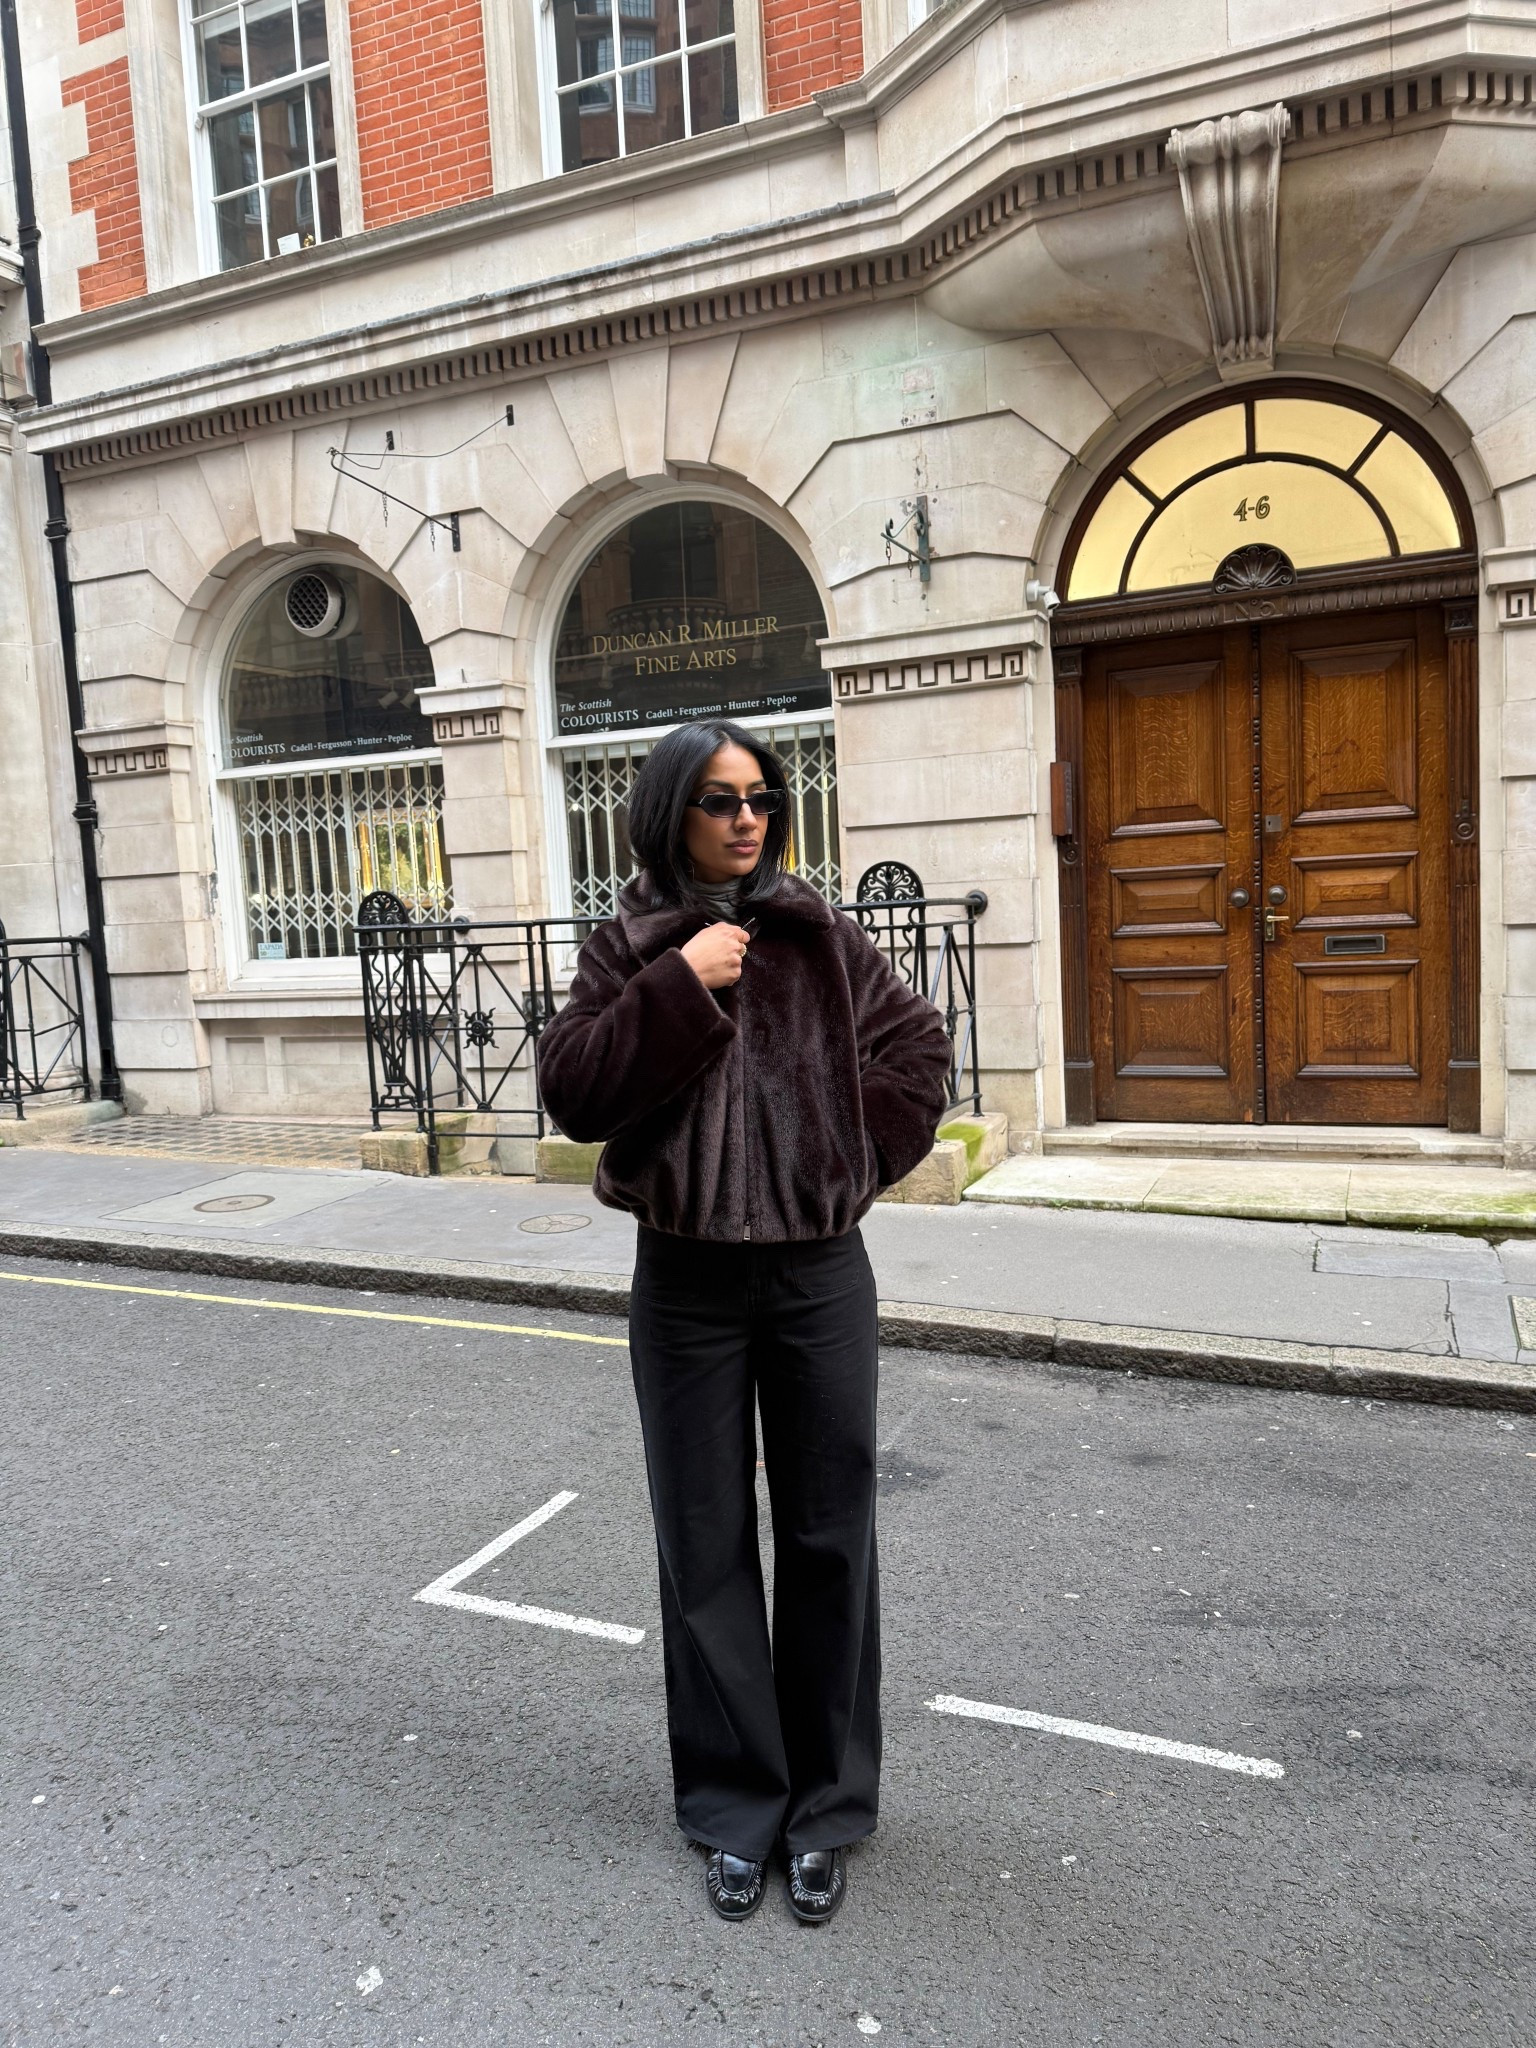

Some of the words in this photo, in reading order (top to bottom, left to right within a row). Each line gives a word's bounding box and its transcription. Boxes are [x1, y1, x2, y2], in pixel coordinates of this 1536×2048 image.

[1233, 495, 1270, 521] 4-6
[592, 629, 672, 654] DUNCAN
[678, 624, 698, 644] R.
[702, 616, 780, 641] MILLER
[635, 655, 681, 676] FINE
[687, 648, 737, 670] ARTS
[560, 702, 576, 713] The
[578, 698, 612, 711] Scottish
[561, 709, 639, 728] COLOURISTS
[645, 708, 673, 719] Cadell
[679, 704, 722, 716] Fergusson
[728, 699, 760, 710] Hunter
[766, 695, 797, 707] Peploe
[236, 733, 263, 744] Scottish
[290, 742, 313, 752] Cadell
[317, 740, 352, 750] Fergusson
[357, 737, 383, 746] Hunter
[387, 733, 412, 744] Peploe
